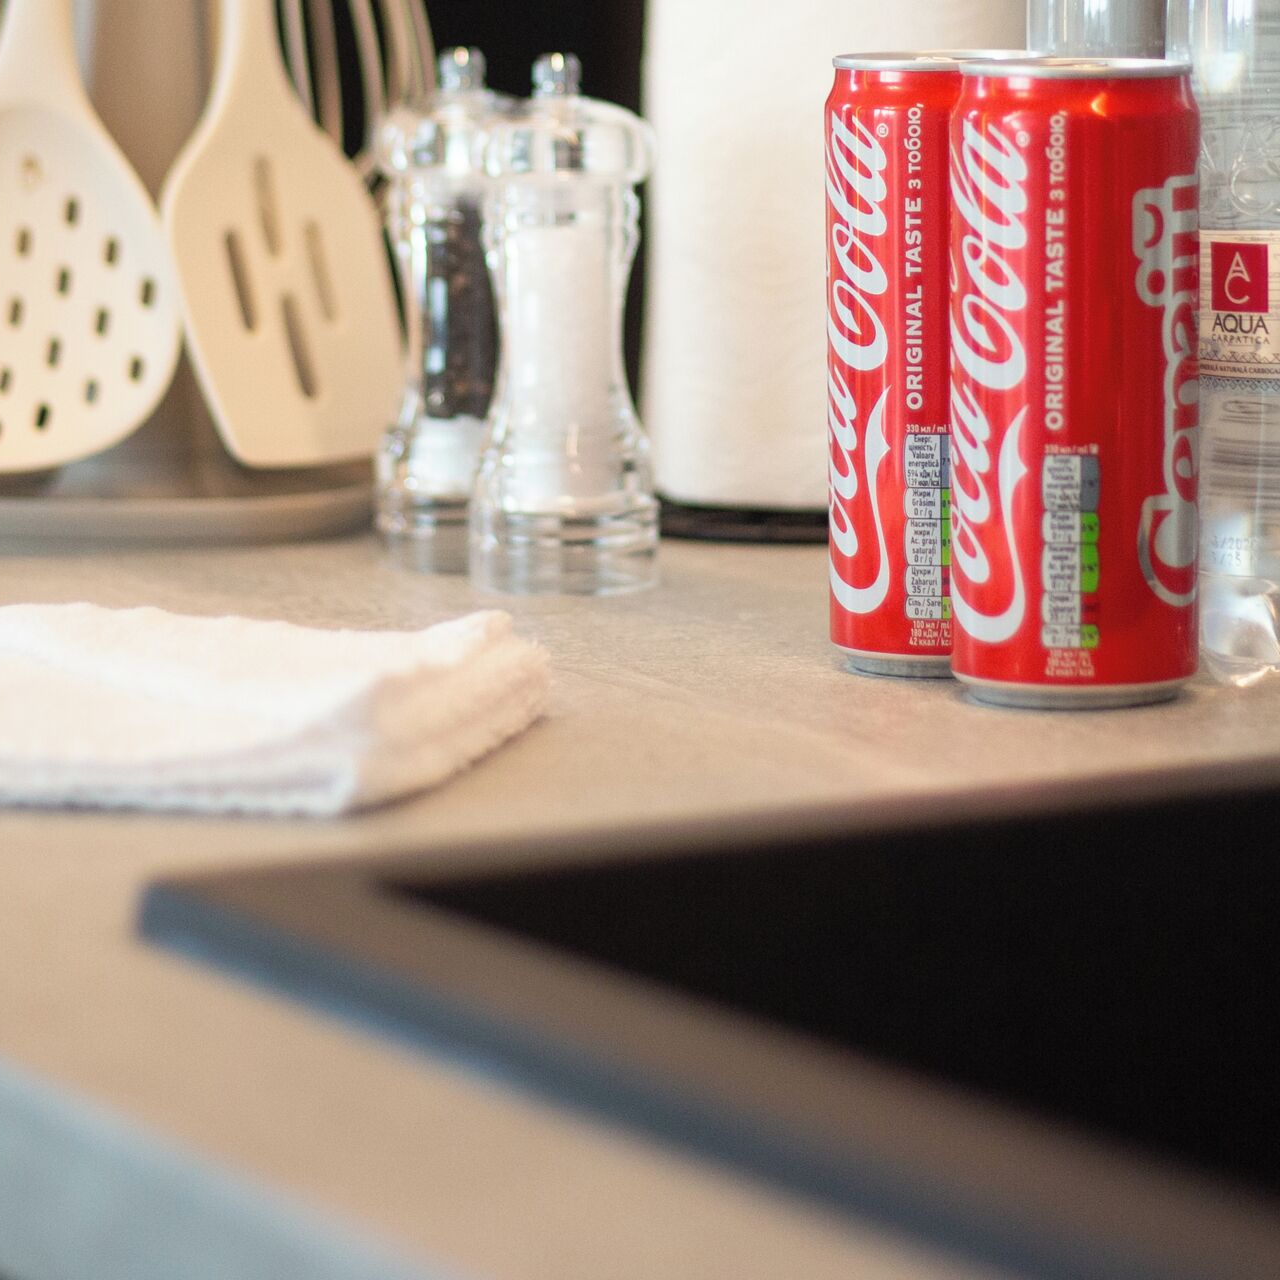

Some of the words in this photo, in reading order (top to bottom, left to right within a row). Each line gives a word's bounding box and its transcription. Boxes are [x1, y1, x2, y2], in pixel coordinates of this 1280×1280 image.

[904, 102, 924, 174] тобою,
[1046, 109, 1067, 184] тобою,
[906, 197, 923, 277] TASTE
[1045, 208, 1064, 293] TASTE
[1212, 314, 1269, 335] AQUA
[1211, 334, 1270, 345] CARPATICA
[906, 285, 923, 410] ORIGINAL
[1045, 300, 1064, 431] ORIGINAL
[1220, 365, 1248, 374] NATURALĂ
[905, 424, 919, 433] 330
[937, 424, 947, 433] ml
[912, 451, 934, 459] Valoare
[908, 459, 939, 469] energetică
[908, 470, 918, 478] 594
[912, 489, 931, 498] Жири
[912, 497, 936, 507] Grăsimi
[914, 509, 919, 517] 0
[911, 520, 938, 528] Насичені
[914, 555, 919, 563] 0
[912, 567, 931, 577] Цукри
[911, 577, 937, 586] Zaharuri
[912, 586, 921, 594] 35
[927, 599, 941, 607] Sare
[913, 621, 924, 629] 100
